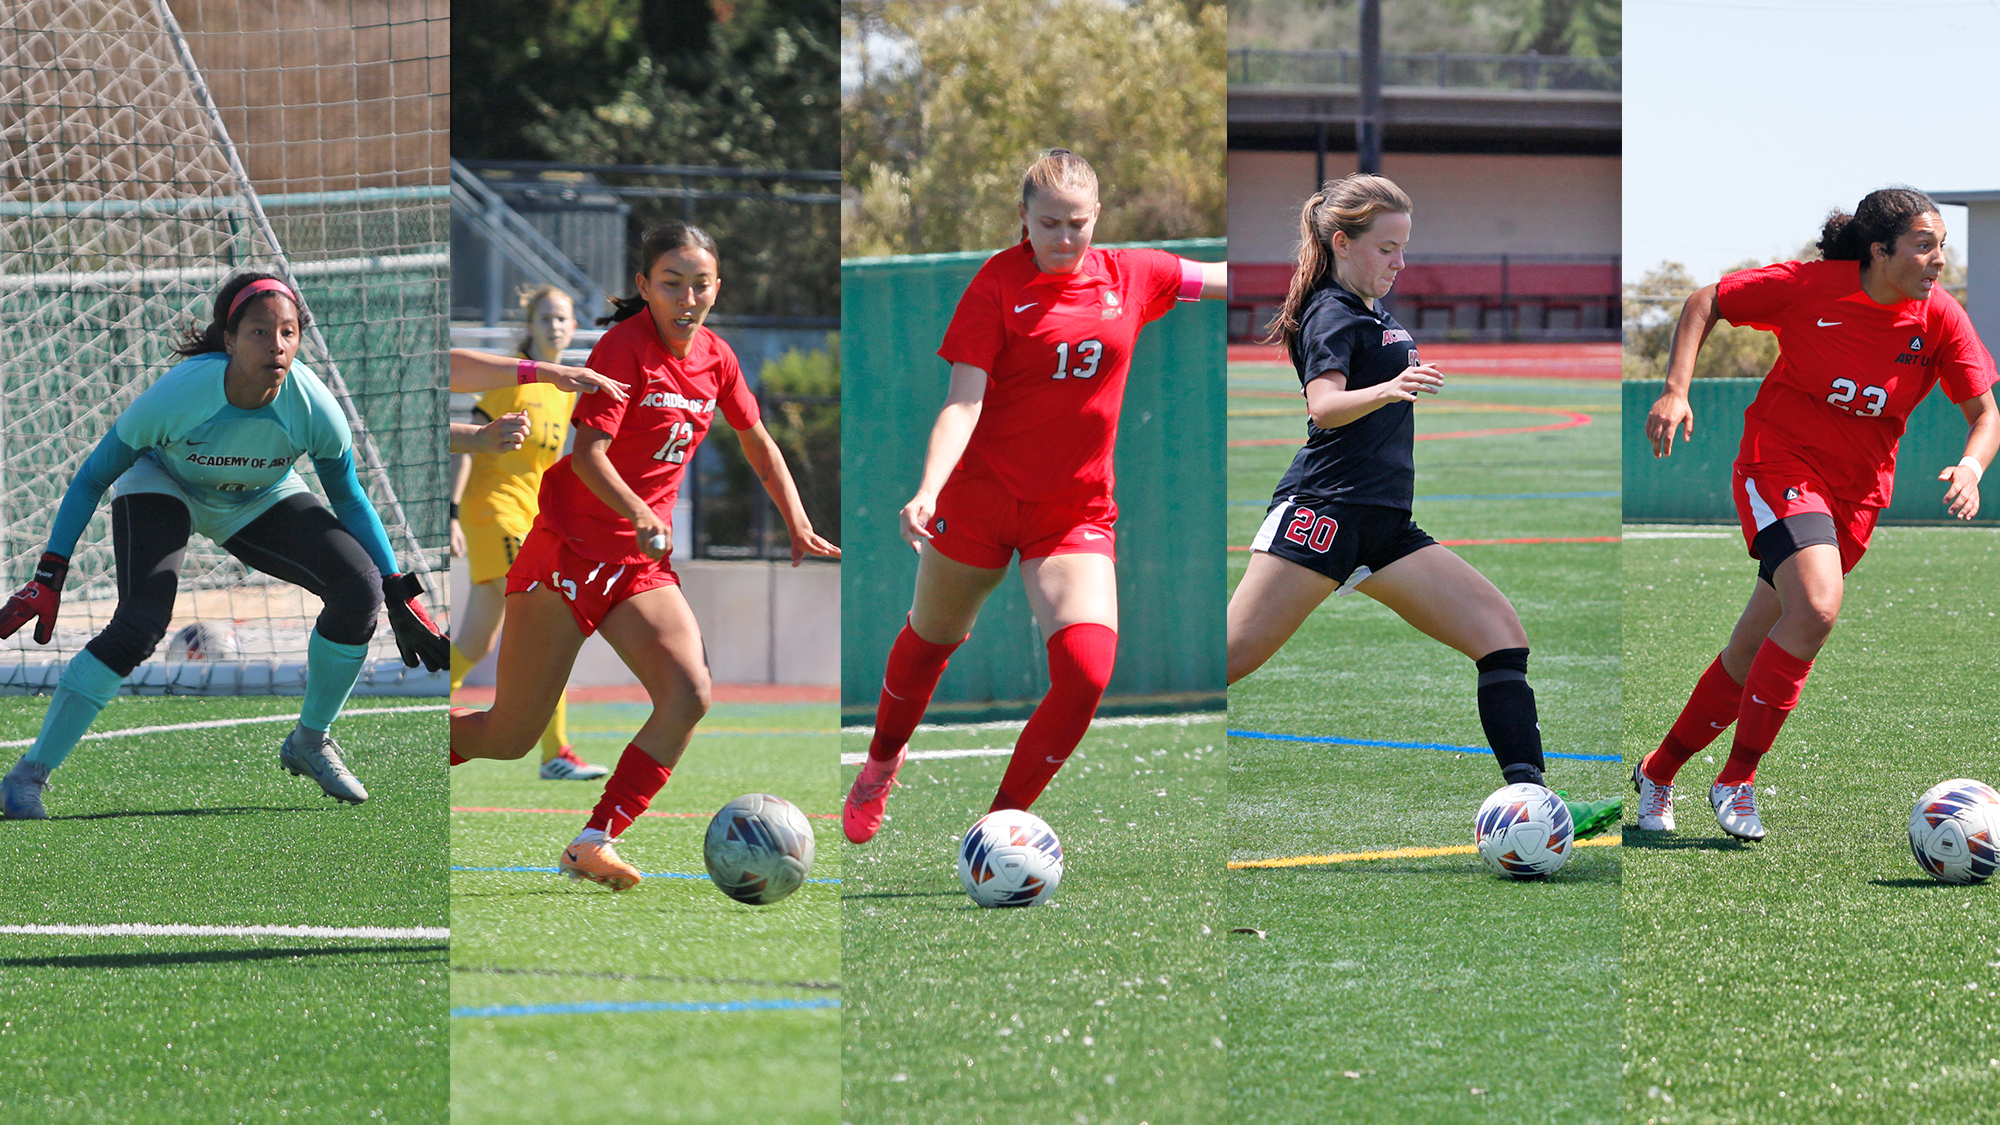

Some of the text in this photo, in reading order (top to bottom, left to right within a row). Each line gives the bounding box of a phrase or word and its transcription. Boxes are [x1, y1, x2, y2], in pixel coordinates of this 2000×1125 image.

[1051, 339, 1103, 379] 13
[1894, 353, 1930, 367] ART U
[1826, 376, 1888, 417] 23
[186, 452, 293, 469] ACADEMY OF ART
[652, 421, 694, 464] 12
[1284, 506, 1338, 554] 20
